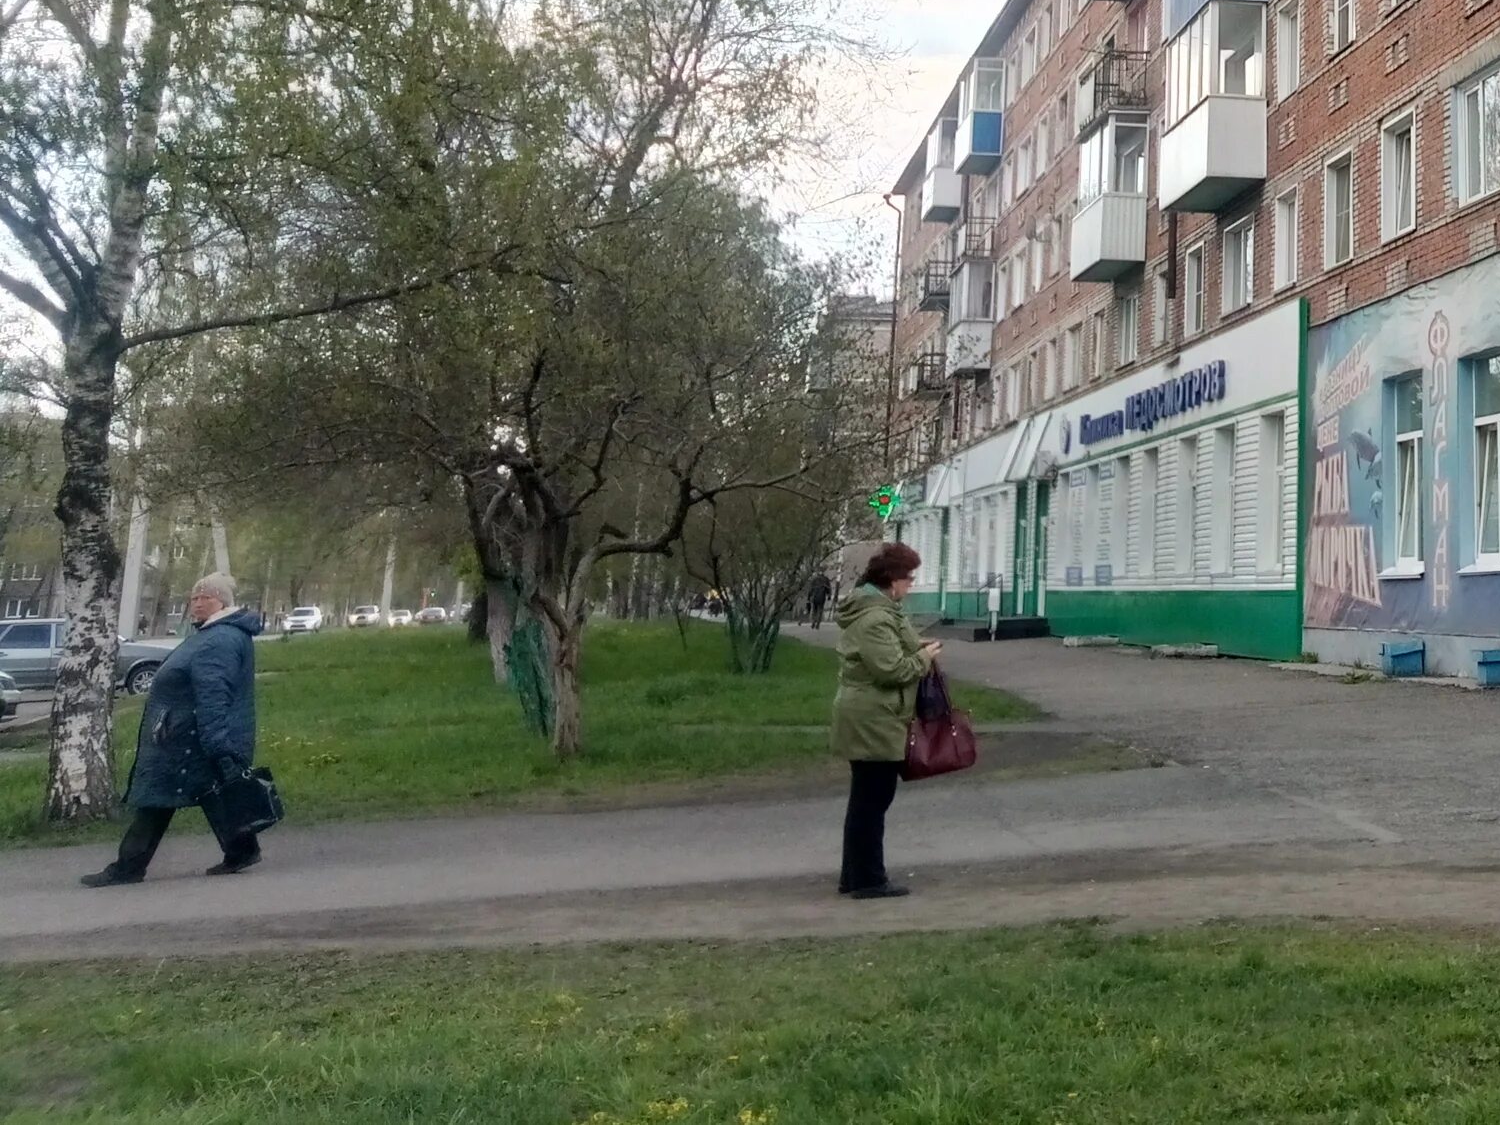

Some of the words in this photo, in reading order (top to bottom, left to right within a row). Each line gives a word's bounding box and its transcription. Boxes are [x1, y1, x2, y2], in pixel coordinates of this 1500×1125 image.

[1125, 360, 1225, 432] МЕДОСМОТРОВ
[1314, 451, 1350, 517] РЫБА
[1428, 310, 1450, 608] ФЛАГМАН
